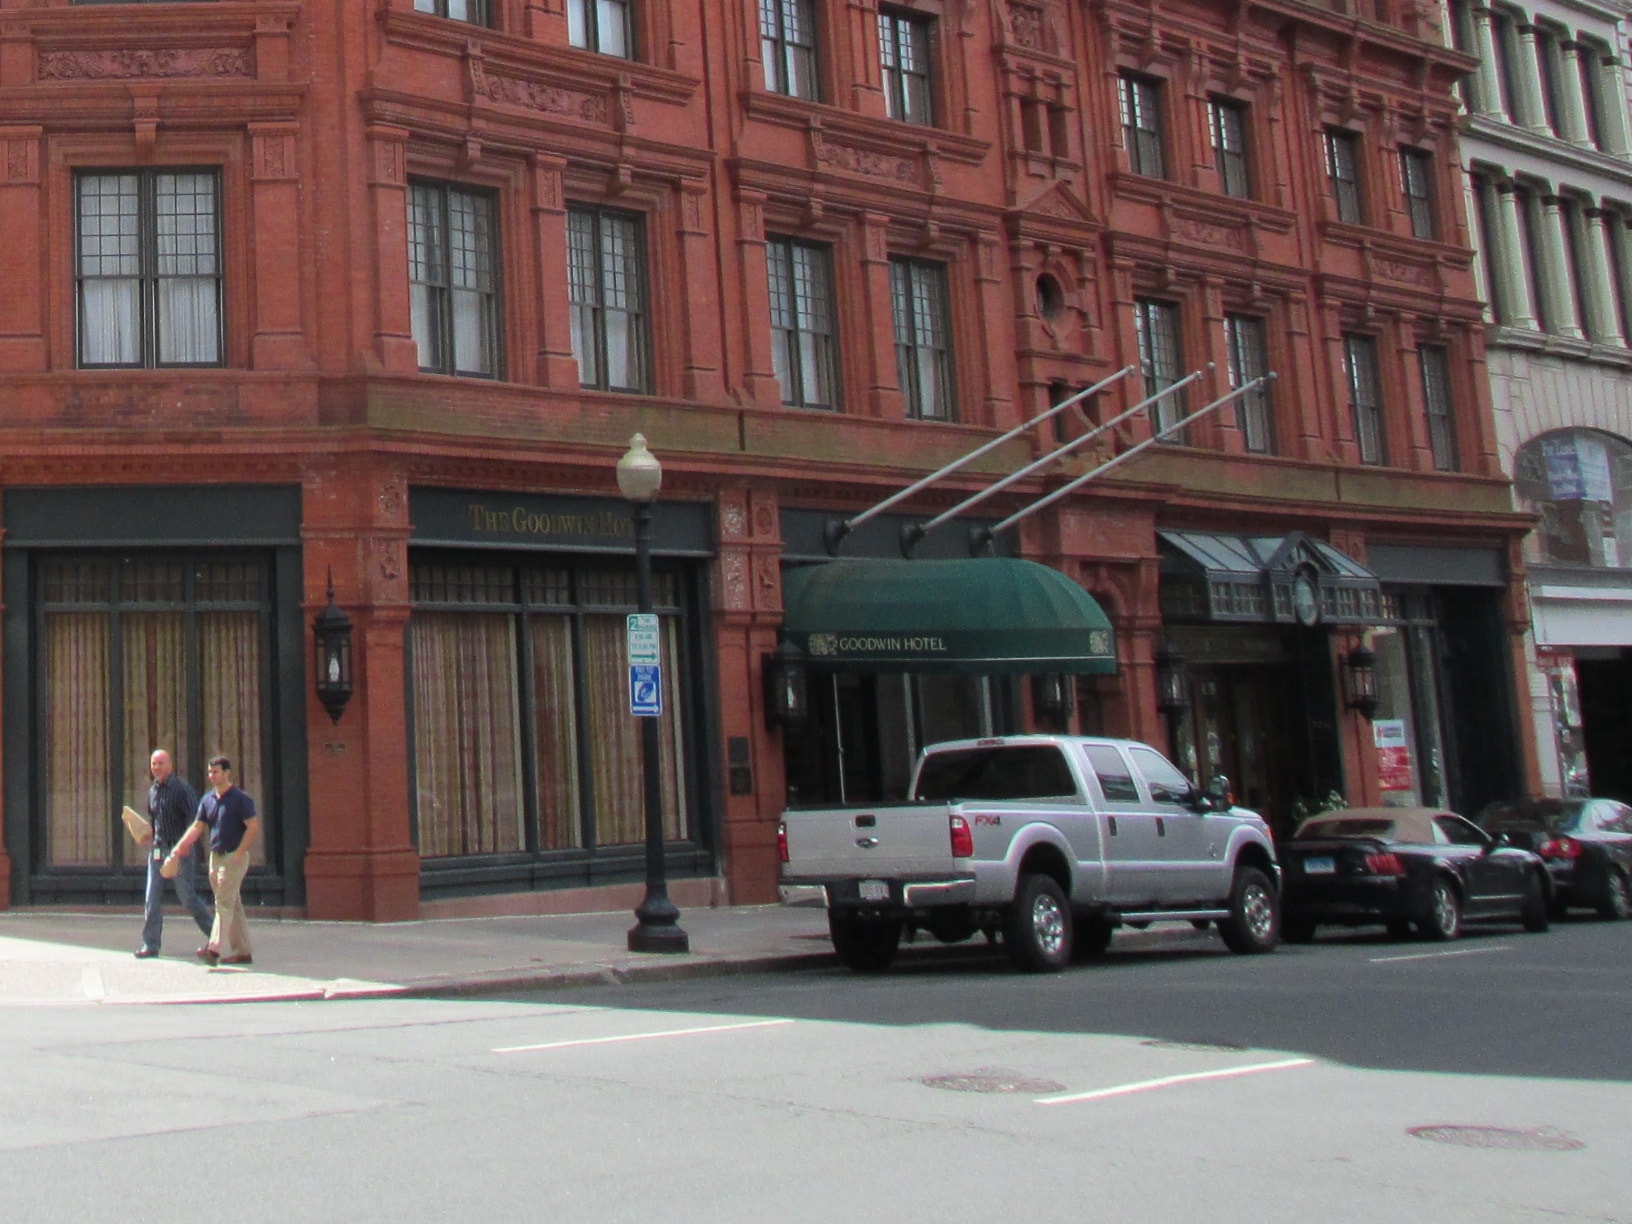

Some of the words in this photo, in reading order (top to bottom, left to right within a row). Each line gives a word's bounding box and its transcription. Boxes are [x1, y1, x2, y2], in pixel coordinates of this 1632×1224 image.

[469, 504, 508, 531] THE
[512, 507, 594, 535] GOODWIN
[598, 511, 635, 537] HOT
[630, 618, 637, 630] 2
[839, 637, 900, 651] GOODWIN
[905, 637, 946, 651] HOTEL
[974, 815, 1001, 827] FX4
